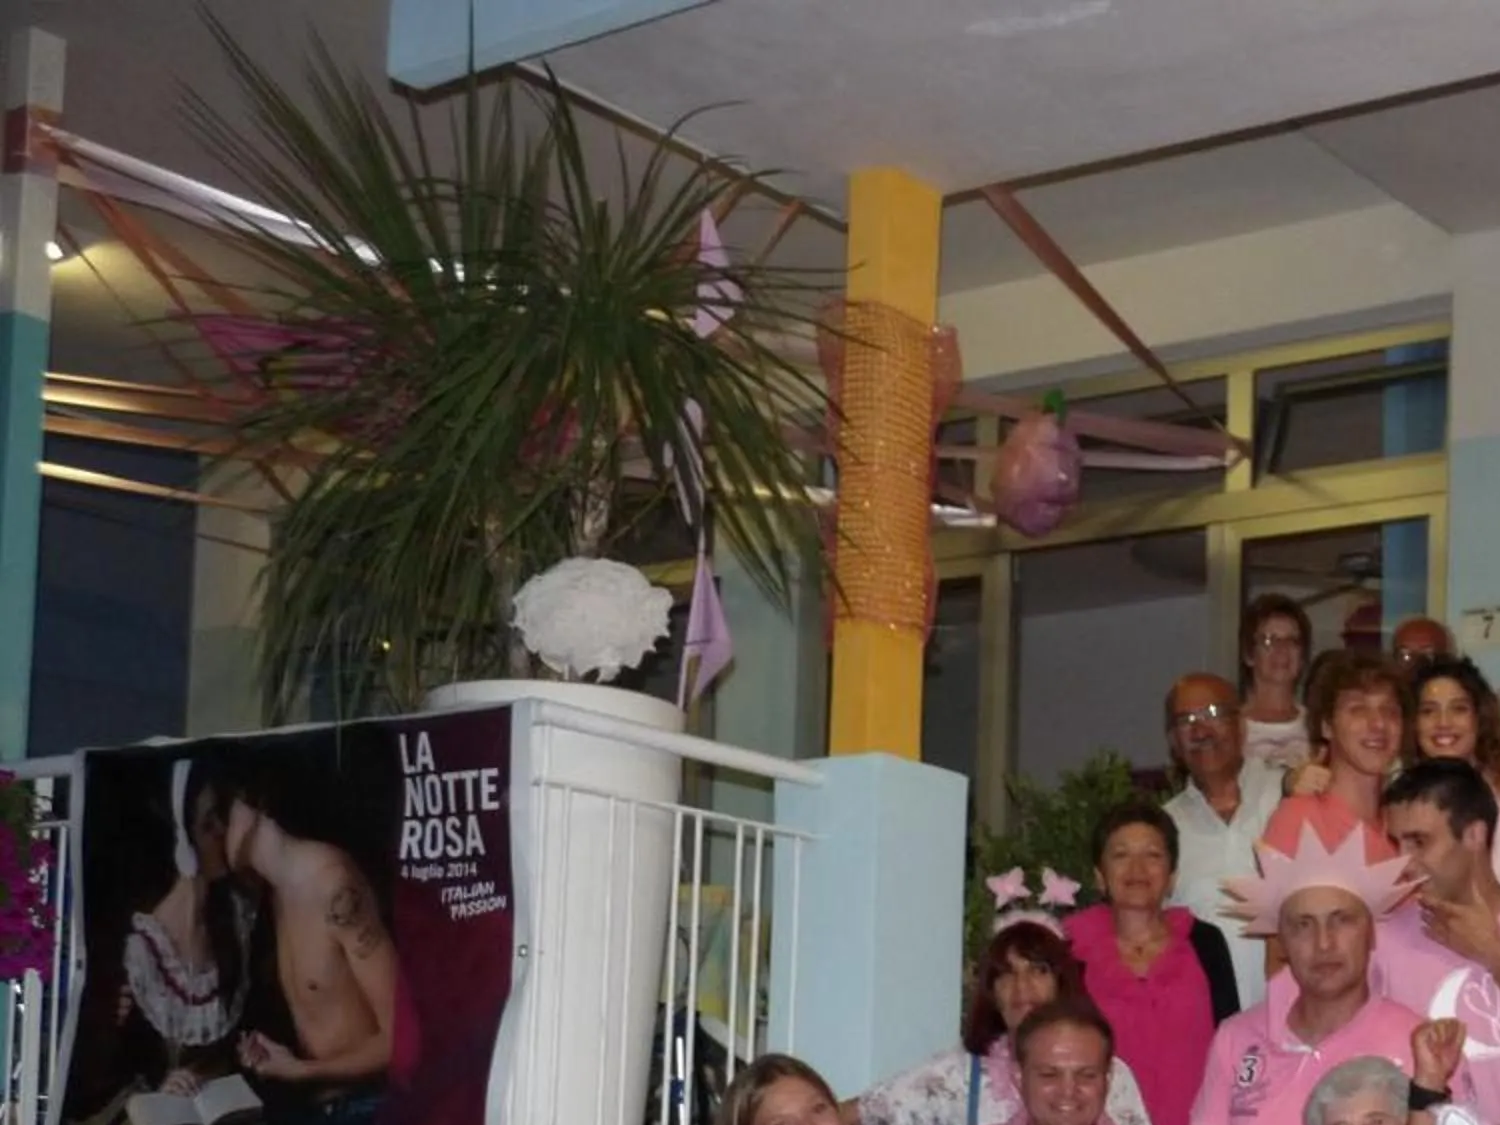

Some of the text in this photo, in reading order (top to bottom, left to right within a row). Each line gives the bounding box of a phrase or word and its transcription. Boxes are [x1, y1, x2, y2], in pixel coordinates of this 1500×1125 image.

[399, 731, 434, 775] LA
[403, 768, 500, 818] NOTTE
[399, 815, 486, 860] ROSA
[447, 862, 478, 879] 2014
[441, 880, 495, 905] ITALIAN
[450, 896, 507, 921] PASSION
[1239, 1057, 1257, 1084] 3
